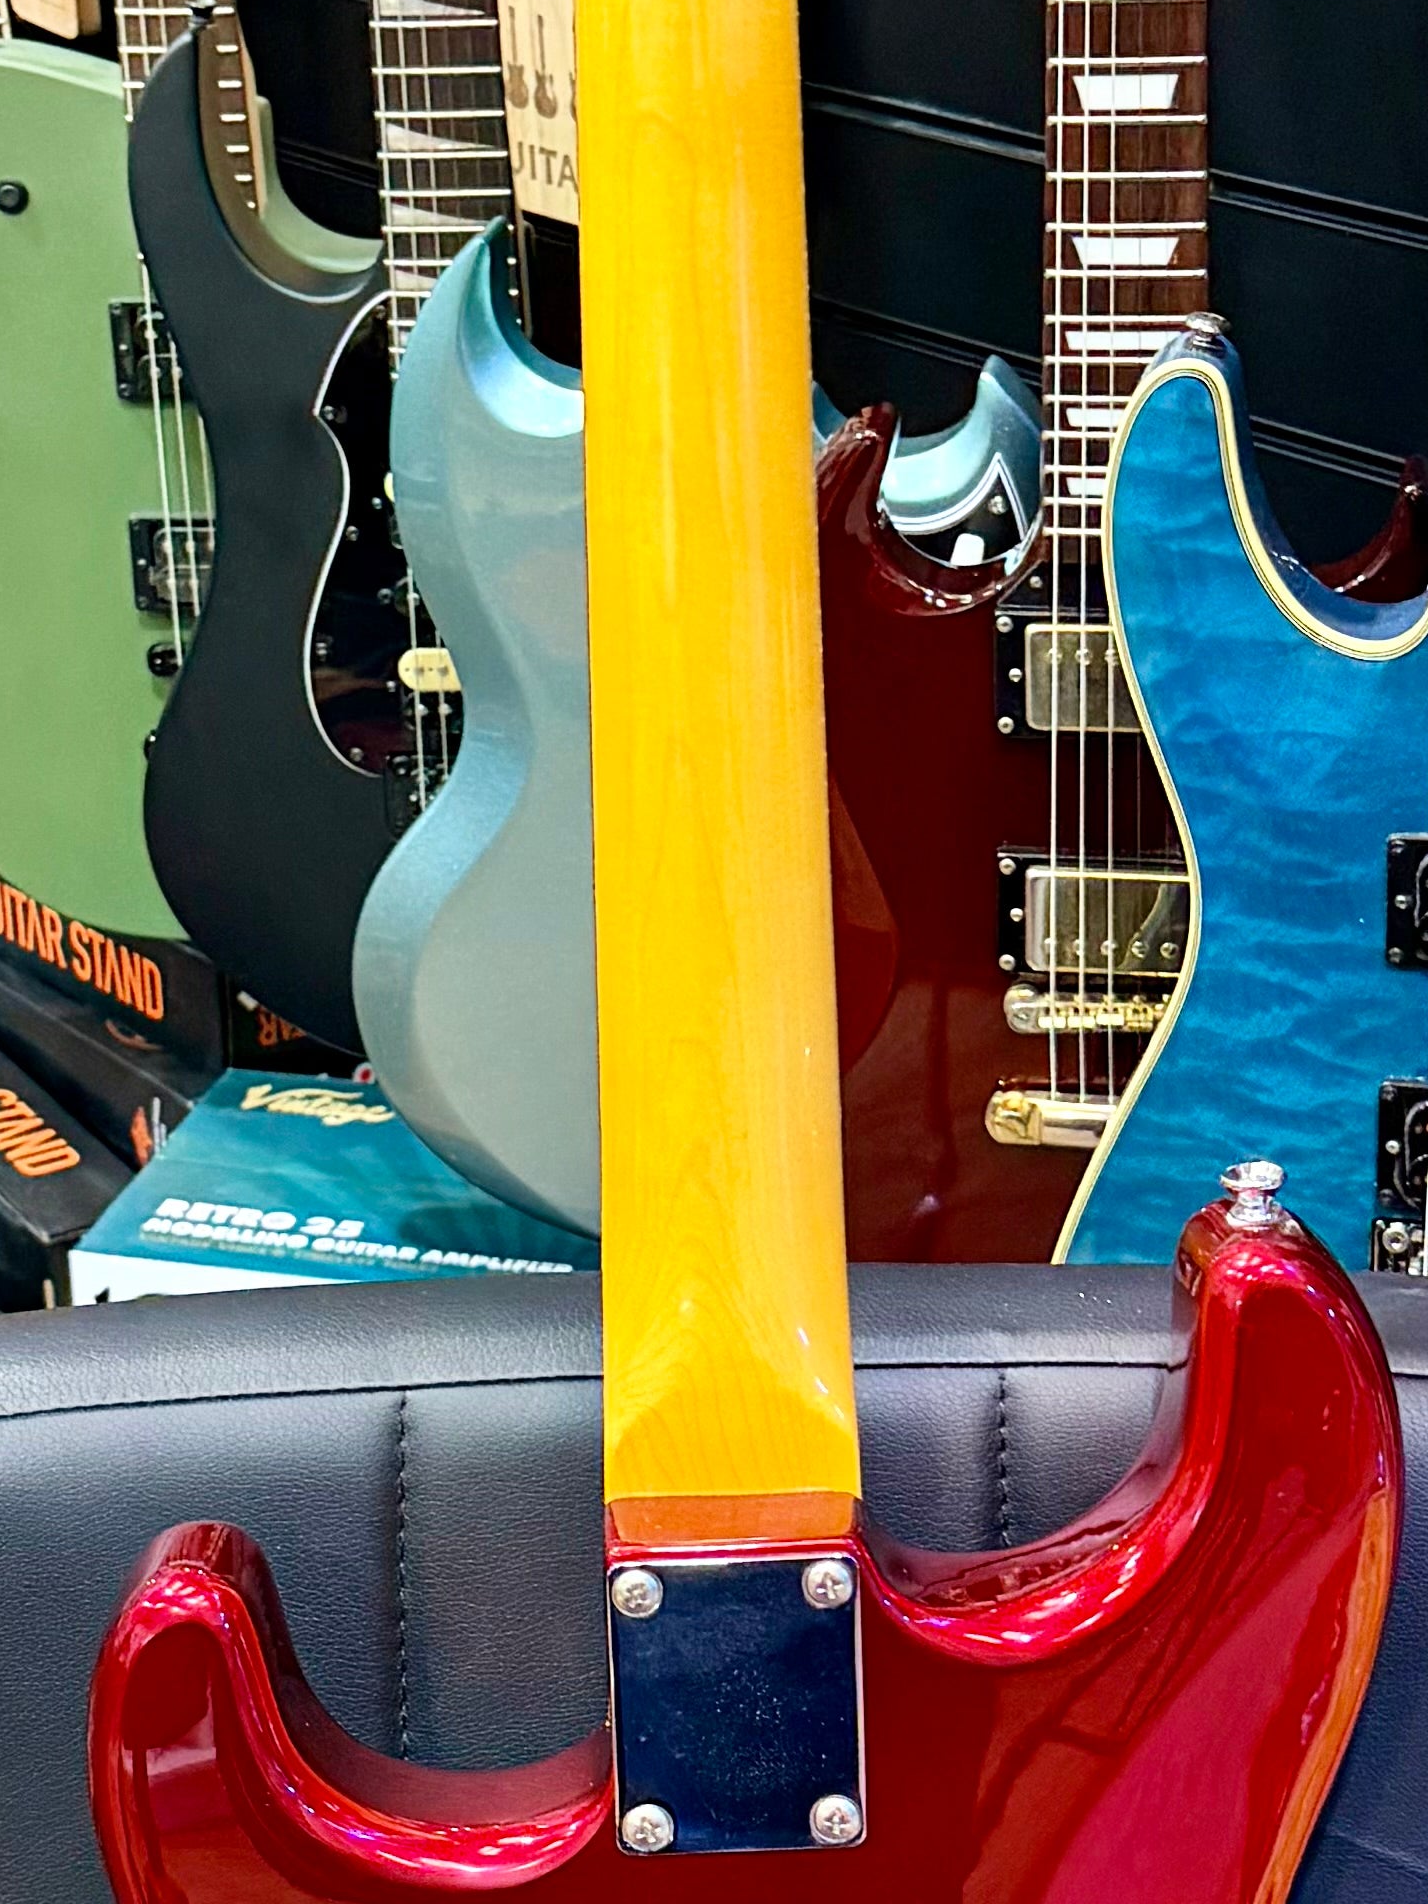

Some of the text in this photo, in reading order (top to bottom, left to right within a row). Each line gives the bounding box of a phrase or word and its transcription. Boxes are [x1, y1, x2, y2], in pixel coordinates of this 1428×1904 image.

[70, 920, 164, 1022] STAND
[240, 1083, 396, 1127] Vintage
[141, 1216, 309, 1249] MODELLING
[312, 1236, 419, 1262] GUITAR
[154, 1198, 365, 1239] RETRO 25
